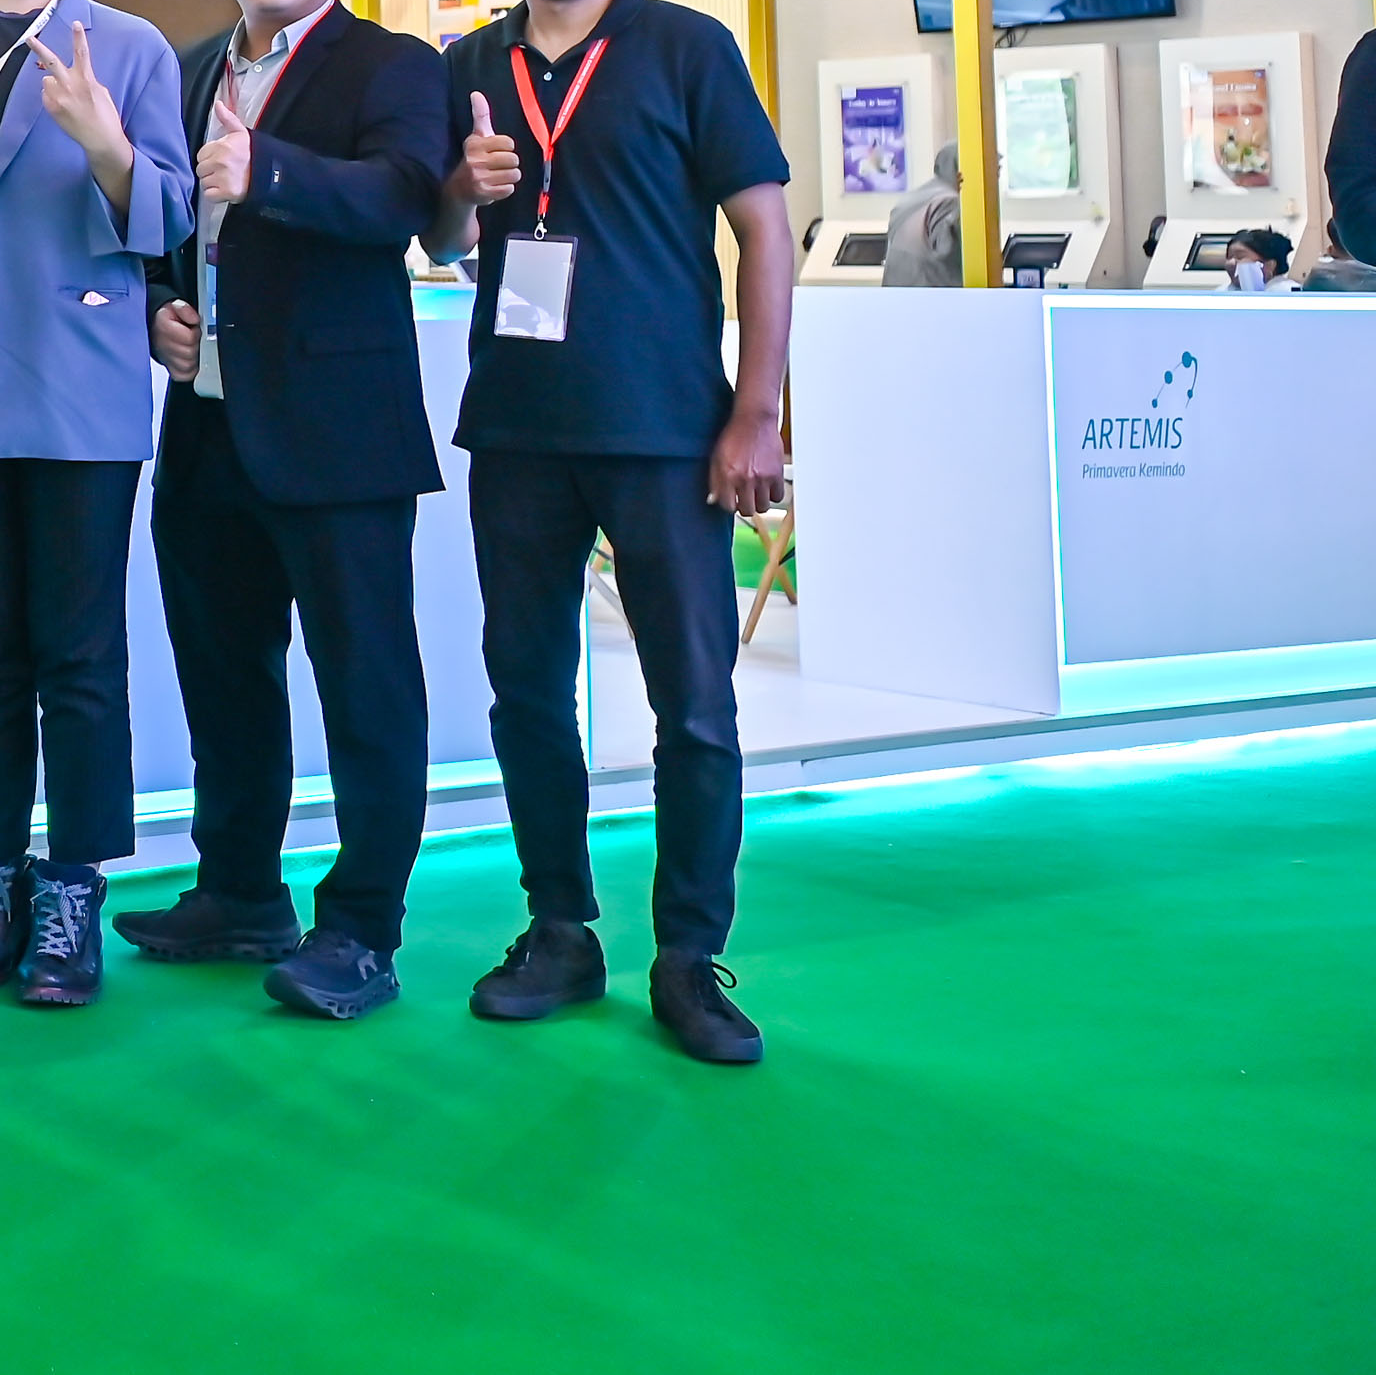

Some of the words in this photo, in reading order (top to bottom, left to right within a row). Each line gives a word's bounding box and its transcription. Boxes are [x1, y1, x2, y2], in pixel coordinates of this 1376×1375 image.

[1082, 416, 1185, 450] ARTEMIS
[1082, 462, 1136, 479] Primavera
[1139, 462, 1186, 479] Kemindo
